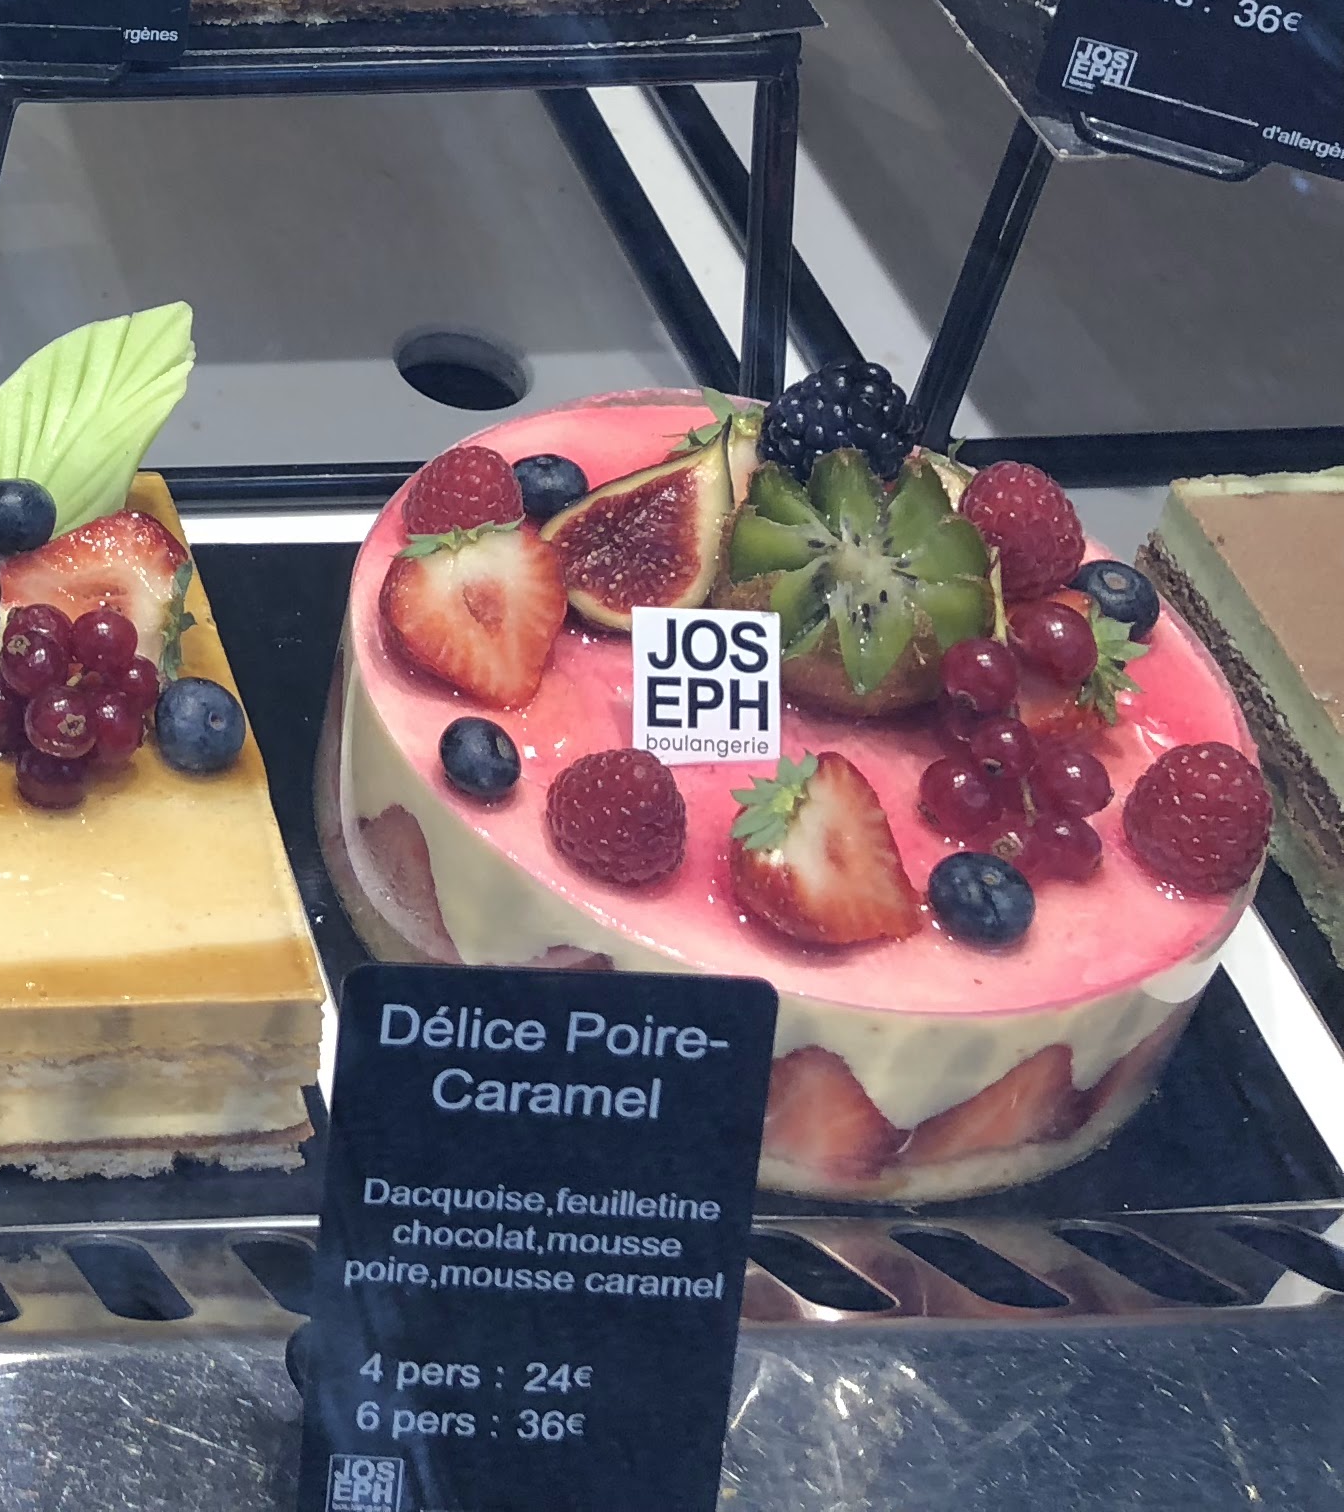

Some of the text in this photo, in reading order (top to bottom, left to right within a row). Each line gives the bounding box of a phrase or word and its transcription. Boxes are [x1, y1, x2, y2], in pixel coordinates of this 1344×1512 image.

[1234, 0, 1302, 33] 36€
[647, 617, 769, 674] JOS
[646, 676, 769, 732] EPH
[646, 733, 769, 758] boulangerie
[380, 1004, 729, 1058] Délice Poire-
[433, 1069, 661, 1118] Caramel
[585, 1273, 723, 1299] caramel
[360, 1353, 593, 1393] 4 pers 24€
[356, 1401, 585, 1440] 6 pers 36€
[334, 1458, 395, 1482] JOS
[333, 1479, 393, 1503] EPH
